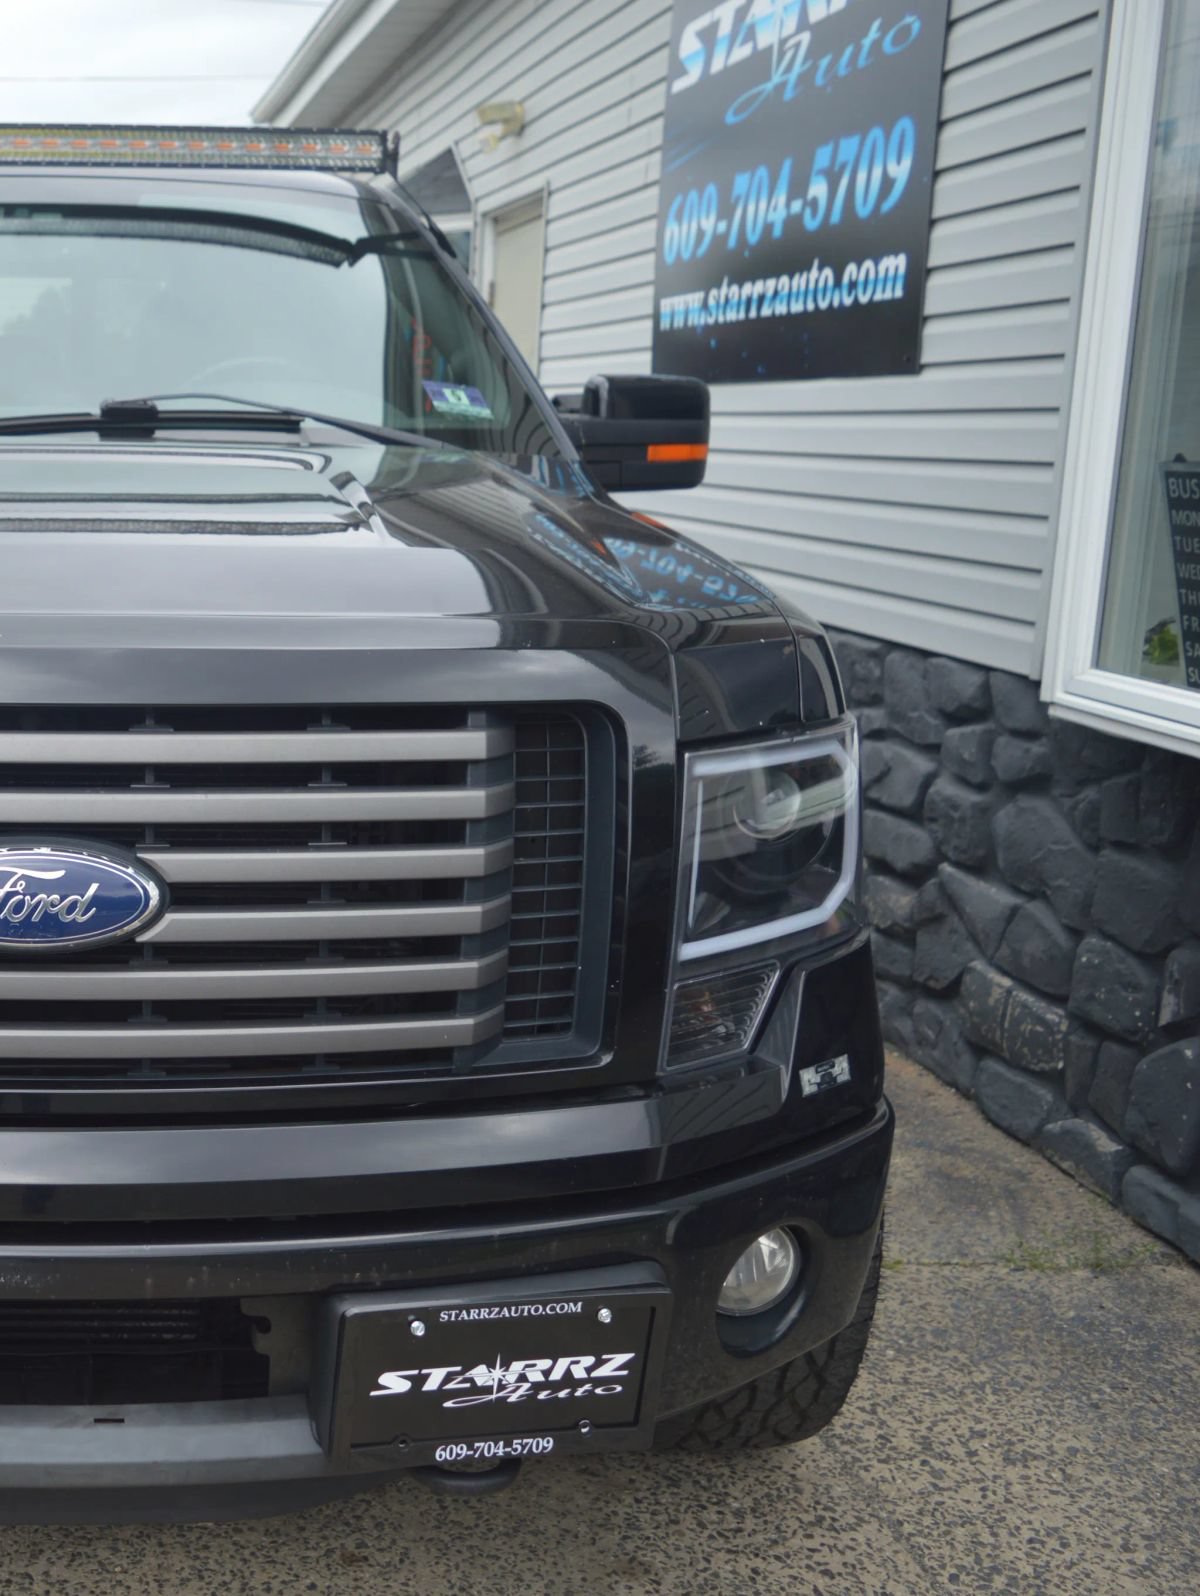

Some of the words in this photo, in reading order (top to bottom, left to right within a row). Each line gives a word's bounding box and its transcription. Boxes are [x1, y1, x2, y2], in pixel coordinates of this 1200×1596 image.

[723, 14, 922, 125] Auto
[662, 115, 916, 267] 609-704-5709
[659, 252, 908, 331] www.starrzauto.com
[439, 1302, 583, 1322] STARRZAUTO.COM
[369, 1353, 636, 1396] STARRZ
[442, 1383, 623, 1407] Auto
[435, 1436, 554, 1461] 609-704-5709
